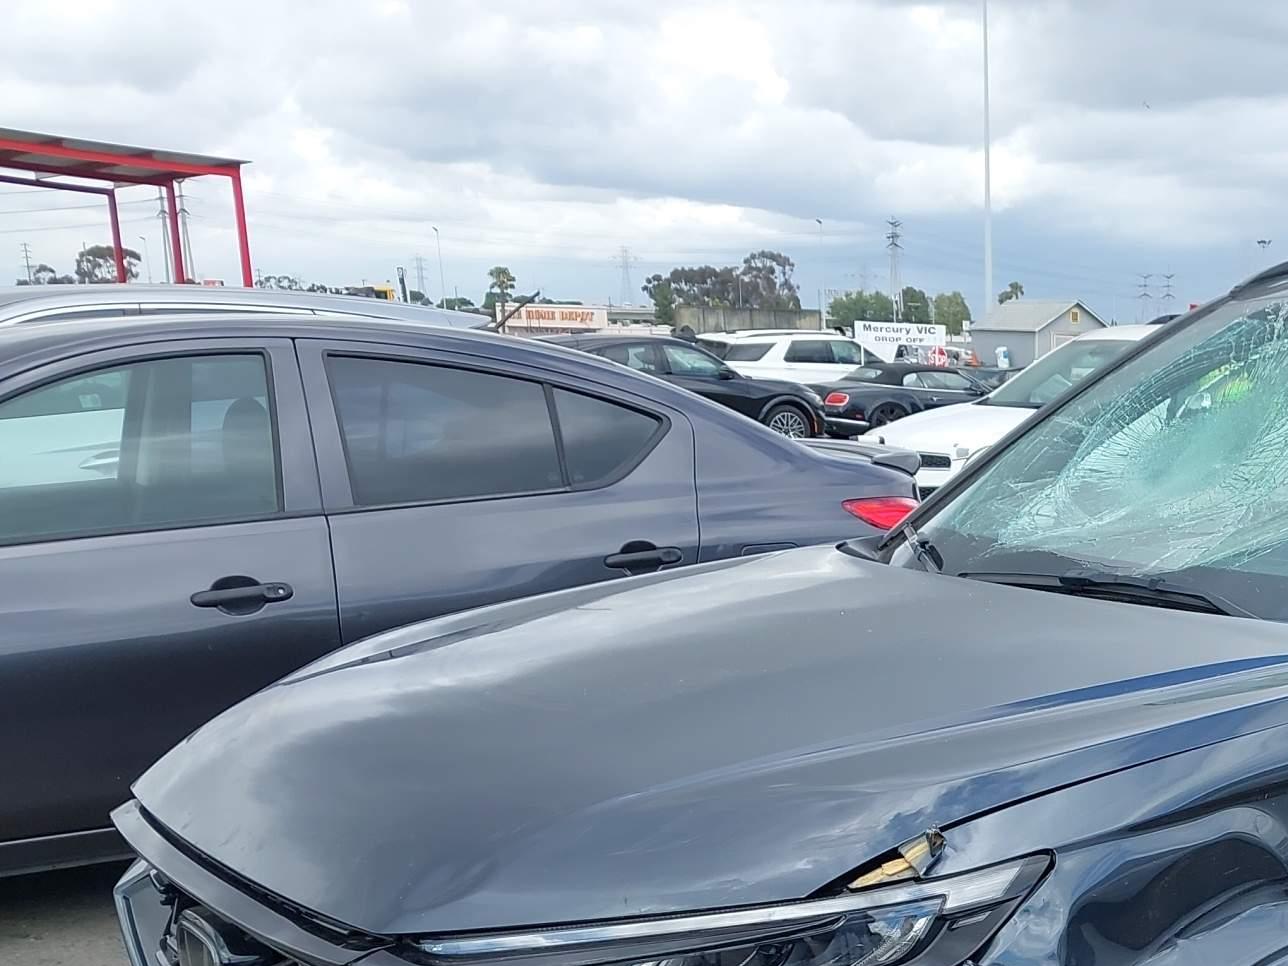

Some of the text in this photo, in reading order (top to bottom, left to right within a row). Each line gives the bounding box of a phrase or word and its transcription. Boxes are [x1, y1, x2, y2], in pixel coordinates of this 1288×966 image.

[863, 324, 937, 335] Mercury VIC
[929, 354, 945, 364] SOP
